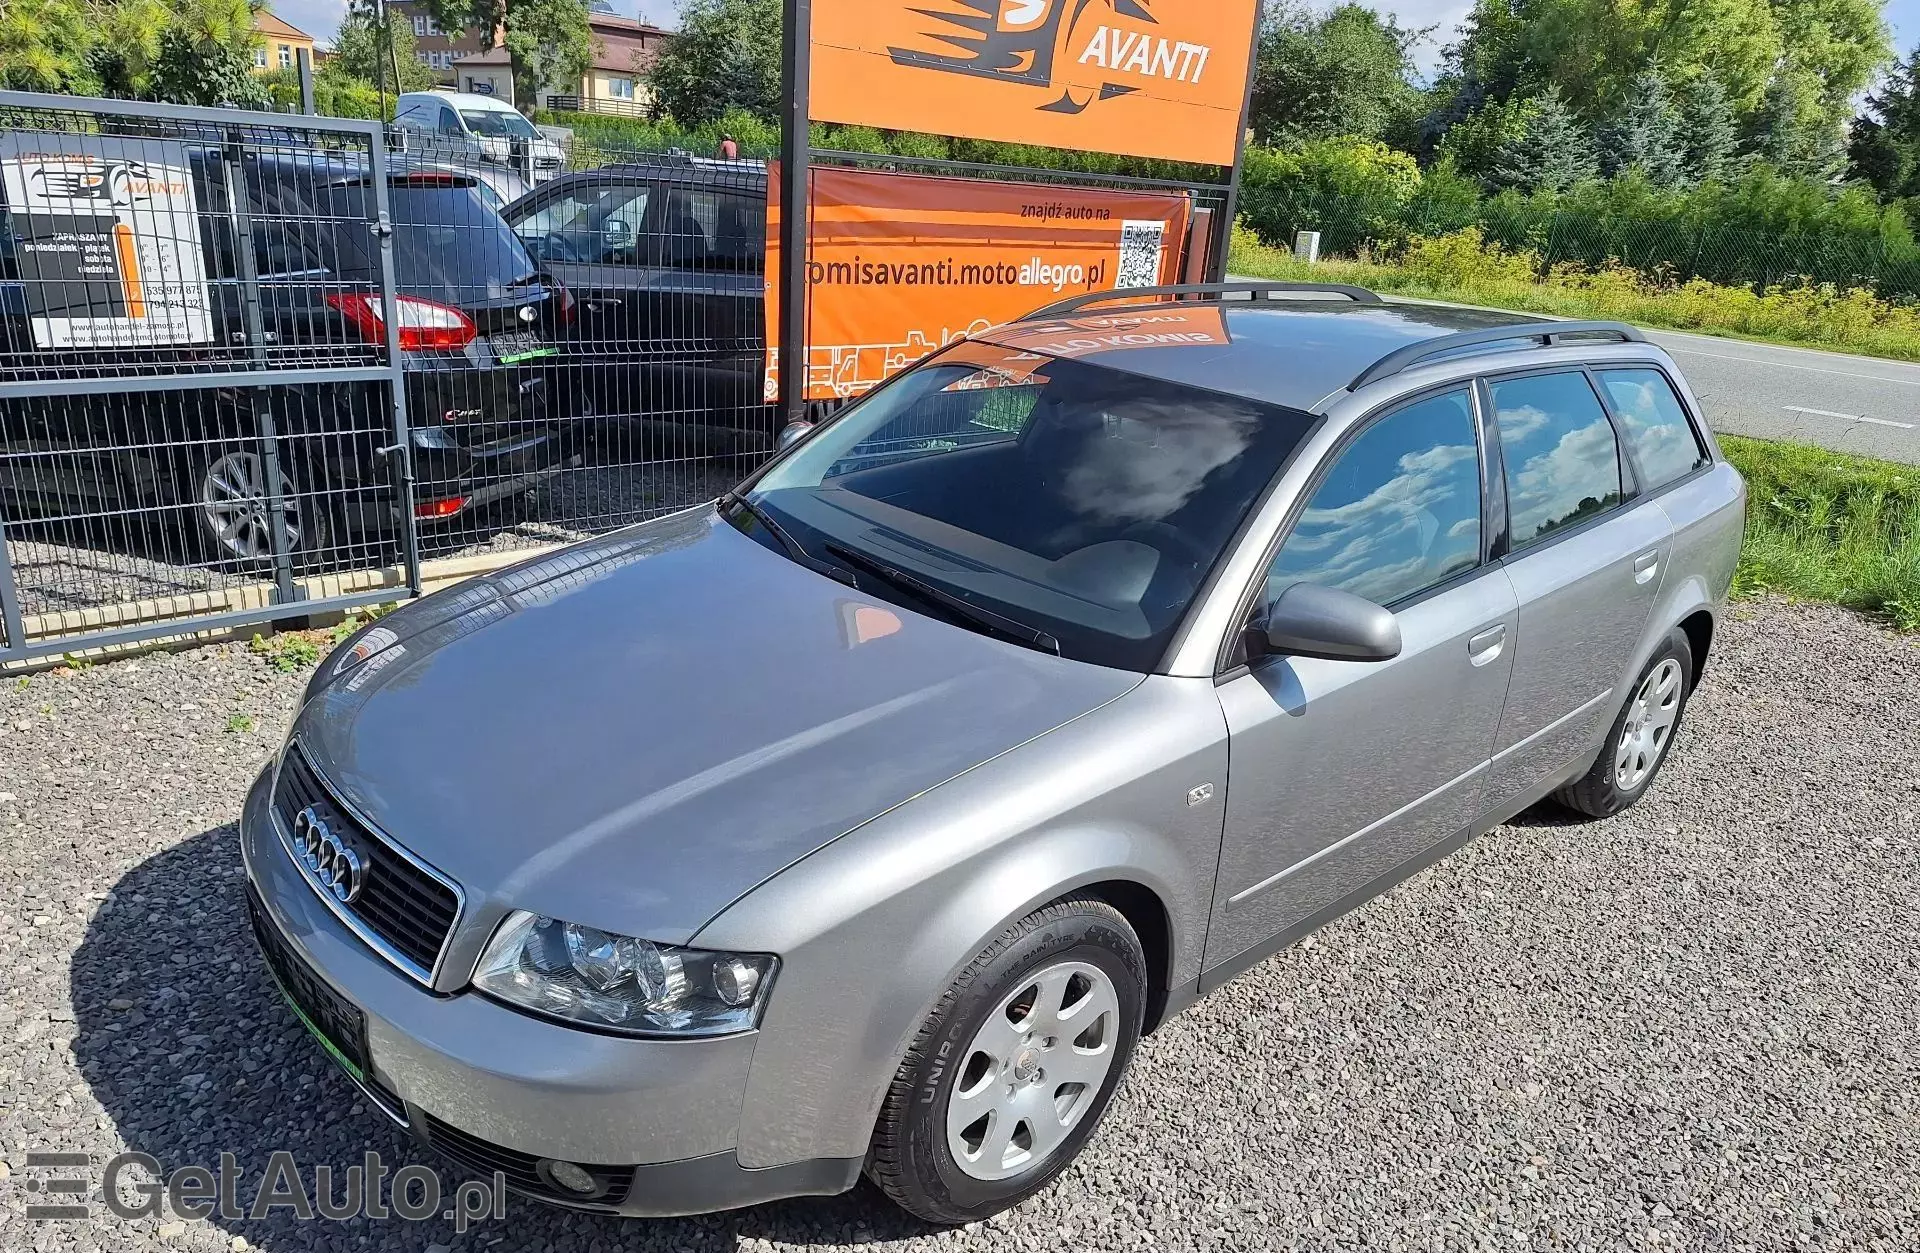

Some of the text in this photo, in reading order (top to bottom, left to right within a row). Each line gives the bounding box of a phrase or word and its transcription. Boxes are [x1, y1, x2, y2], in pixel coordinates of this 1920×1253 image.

[1077, 25, 1211, 84] AVANTI
[53, 153, 95, 165] KOMS
[122, 182, 188, 194] AVANTI
[1020, 202, 1110, 223] znajdź auto na
[85, 244, 111, 253] piąek
[147, 286, 165, 296] 535
